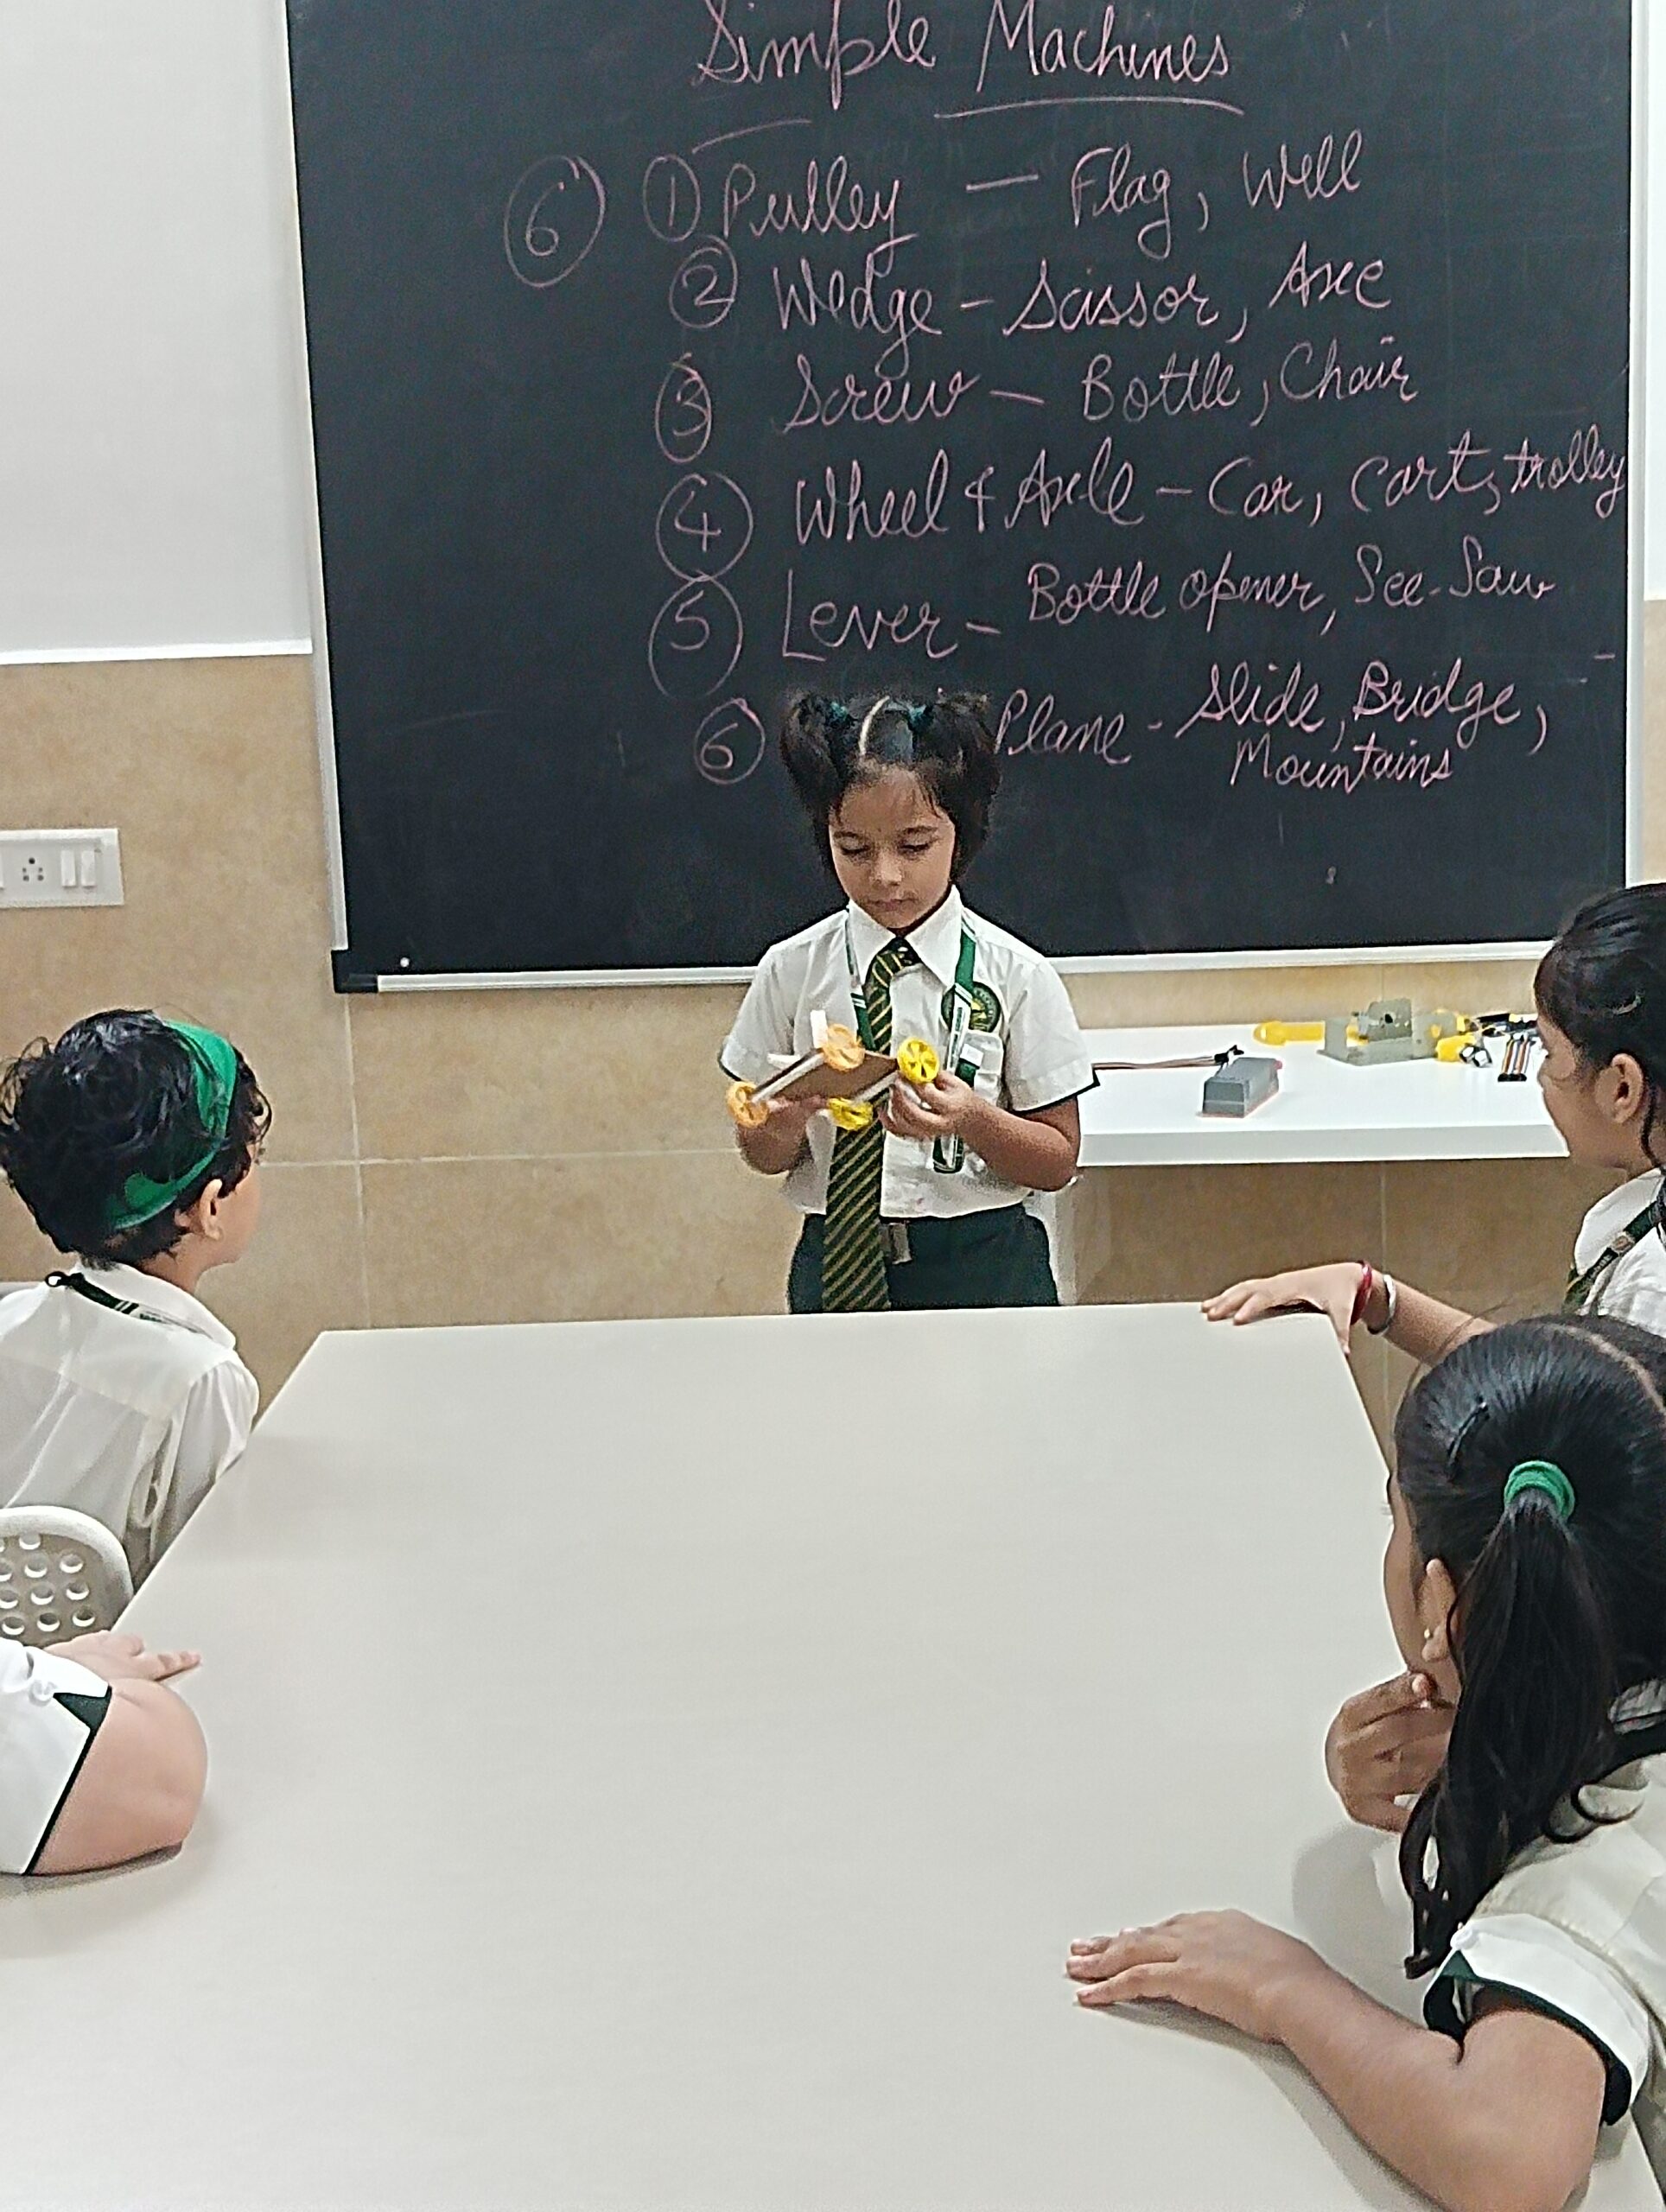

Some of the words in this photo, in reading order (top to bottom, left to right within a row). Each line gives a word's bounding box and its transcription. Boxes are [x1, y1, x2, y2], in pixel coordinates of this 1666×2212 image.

[691, 0, 937, 110] Simple
[976, 0, 1230, 92] Machines
[722, 156, 919, 277] Pulley
[1243, 130, 1362, 210] Well
[773, 257, 943, 380] Wedge
[782, 353, 982, 434] Screw
[1279, 336, 1419, 404] Chair
[795, 448, 949, 544] Wheel
[1005, 437, 1145, 526] Axle
[1503, 423, 1626, 519] trolley
[782, 569, 959, 661] Lever
[1028, 561, 1167, 625] Bottle
[994, 690, 1132, 765] Plane
[1230, 731, 1454, 794] Mountains
